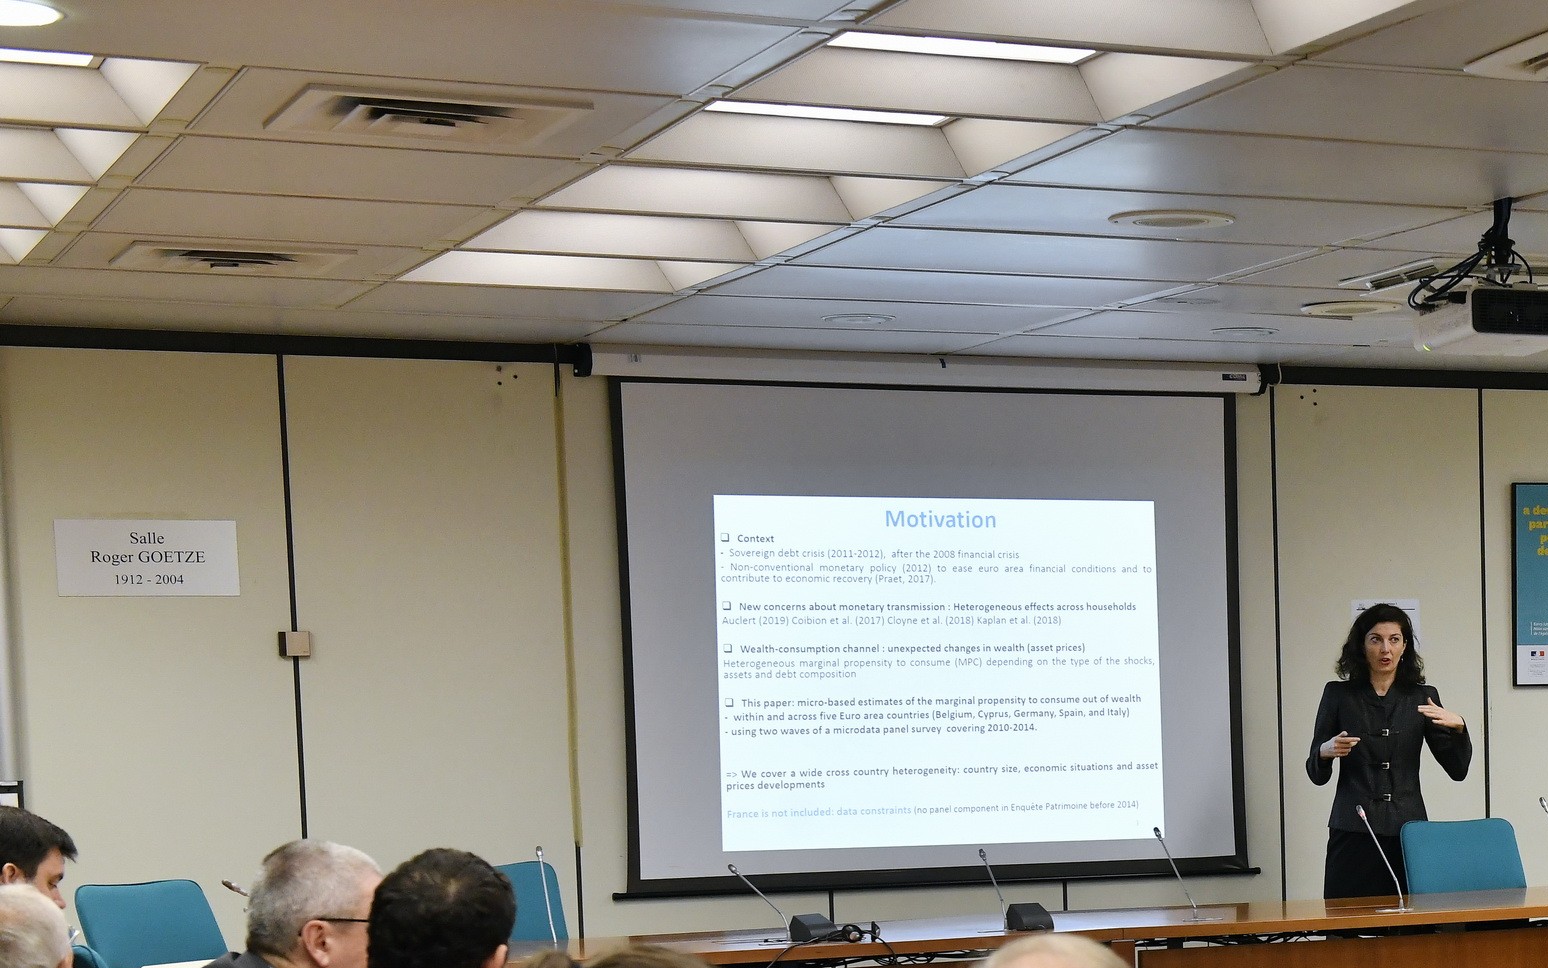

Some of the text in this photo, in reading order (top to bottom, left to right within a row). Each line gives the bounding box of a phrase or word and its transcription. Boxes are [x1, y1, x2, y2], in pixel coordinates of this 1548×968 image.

[885, 509, 996, 528] Motivation
[130, 532, 165, 544] Salle
[737, 534, 774, 542] Context
[91, 551, 206, 566] Roger GOETZE
[729, 548, 1019, 559] Sovereign debt crisis (2011-2012), after the 2008 financial crisis
[115, 575, 184, 584] 1912 2004
[739, 602, 761, 610] New
[808, 601, 836, 610] about
[838, 603, 884, 613] monetary
[886, 602, 945, 610] transmission
[953, 602, 1022, 613] Heterogeneous
[1024, 601, 1054, 611] effects
[1086, 601, 1136, 610] households
[739, 642, 1085, 655] Wealth-consumption channel unexpected changes in wealth (asset prices)
[723, 659, 795, 670] Heterogeneous
[799, 658, 839, 669] marginal
[843, 659, 892, 669] propensity
[954, 657, 982, 667] (MPC)
[986, 657, 1033, 668] depending
[1051, 657, 1066, 665] the
[1070, 658, 1089, 667] type
[1093, 656, 1102, 665] of
[1106, 656, 1120, 665] the
[1124, 656, 1154, 665] shocks,
[723, 669, 856, 680] assets and debt composition
[741, 698, 761, 707] This
[763, 700, 794, 709] paper:
[797, 697, 855, 707] micro-based
[857, 697, 902, 706] estimates
[905, 696, 915, 705] of
[917, 696, 932, 705] the
[935, 695, 975, 707] marginal
[977, 695, 1026, 706] propensity
[1082, 695, 1097, 703] out
[1099, 694, 1109, 703] of
[1110, 694, 1141, 702] wealth
[733, 712, 764, 721] within
[766, 711, 784, 720] and
[819, 711, 837, 720] five
[839, 711, 860, 720] Euro
[886, 710, 929, 719] countries
[931, 709, 975, 721] (Belgium,
[977, 709, 1011, 720] Cyprus,
[1013, 709, 1056, 719] Germany,
[1058, 708, 1085, 718] Spain,
[1088, 707, 1104, 716] and
[1107, 707, 1129, 718] Italy)
[731, 726, 756, 738] using
[759, 727, 778, 735] two
[812, 725, 822, 734] of
[833, 725, 880, 734] microdata
[882, 724, 908, 735] panel
[911, 726, 941, 735] survey
[946, 723, 985, 735] covering
[987, 723, 1037, 732] 2010-2014.
[740, 769, 757, 778] We
[799, 767, 822, 777] wide
[853, 768, 889, 778] country
[892, 765, 959, 777] heterogeneity:
[963, 765, 998, 776] country
[1001, 764, 1020, 773] size,
[1023, 763, 1066, 772] economic
[1070, 762, 1113, 771] situations
[1116, 761, 1132, 770] and
[726, 779, 825, 792] prices developments
